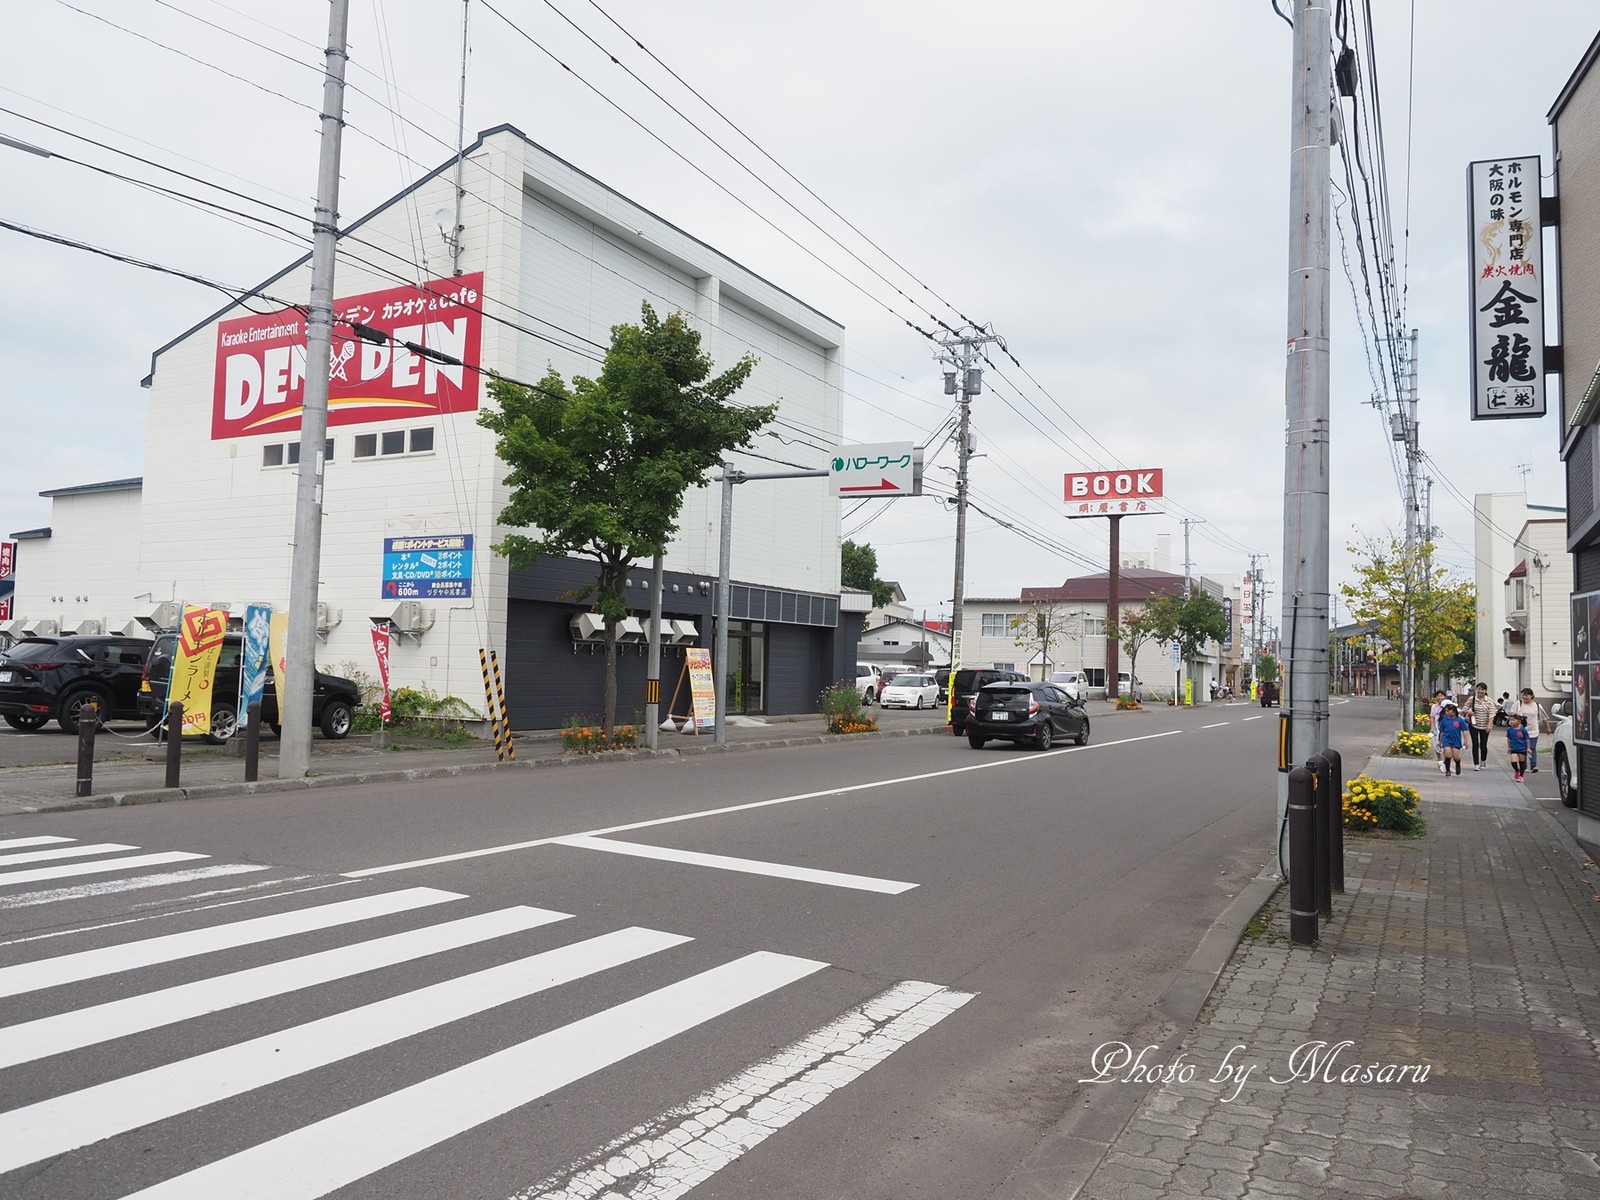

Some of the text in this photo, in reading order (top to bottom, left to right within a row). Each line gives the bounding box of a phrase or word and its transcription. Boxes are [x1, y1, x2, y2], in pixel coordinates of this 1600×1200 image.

[1489, 164, 1505, 221] 大阪の味
[1508, 162, 1524, 261] ホルモン専門店
[1481, 263, 1535, 279] 炭火焼肉
[382, 297, 428, 320] カラオケ
[428, 299, 438, 310] &
[221, 320, 299, 347] Karaoke Entertainment
[1479, 279, 1538, 383] 金龍
[360, 317, 468, 395] DEN
[1491, 393, 1530, 407] 仁栄
[845, 454, 911, 472] ハローワーク
[1071, 473, 1154, 497] BOOK
[398, 588, 419, 596] 600m
